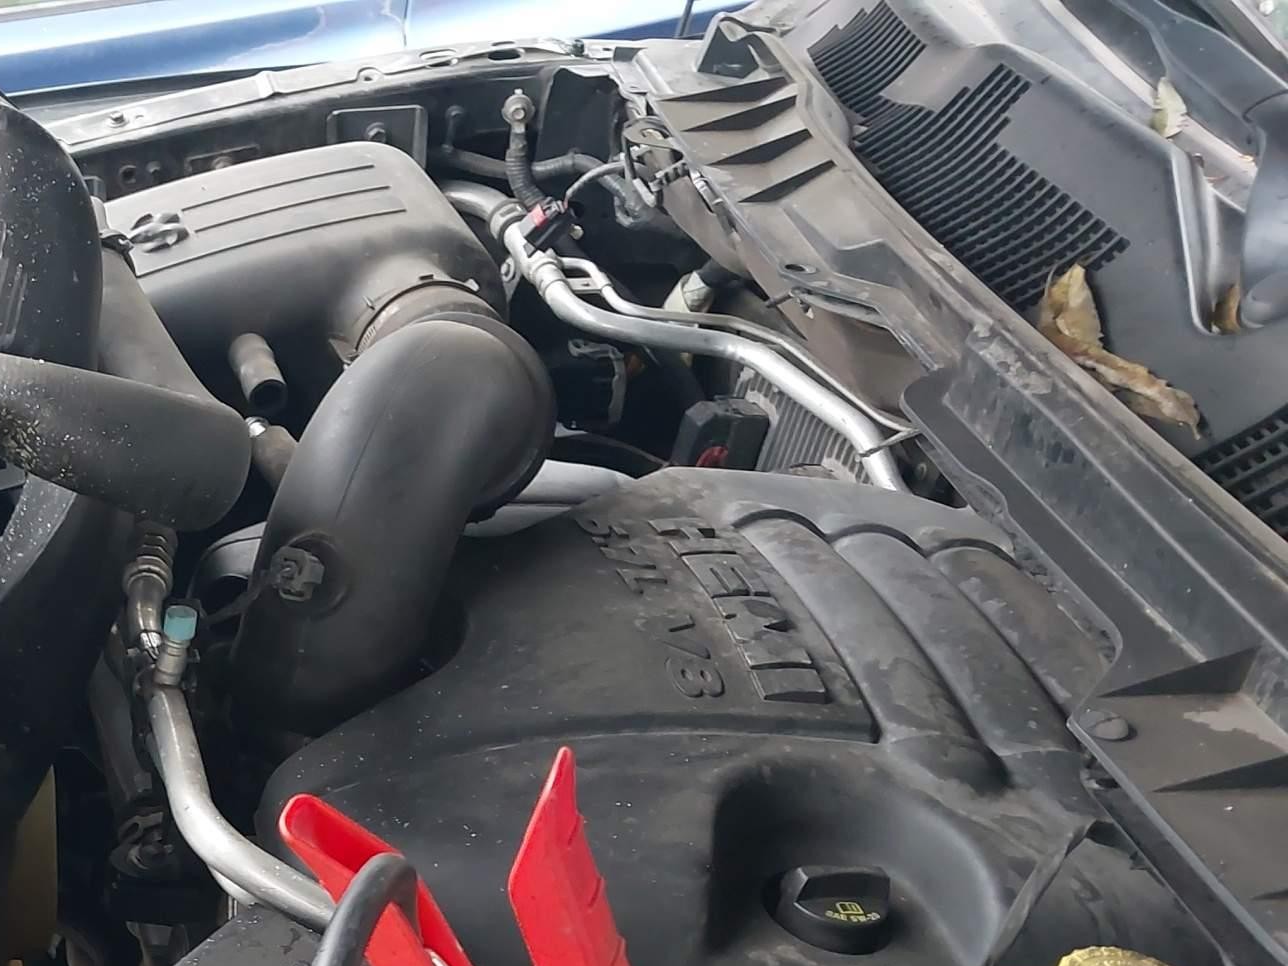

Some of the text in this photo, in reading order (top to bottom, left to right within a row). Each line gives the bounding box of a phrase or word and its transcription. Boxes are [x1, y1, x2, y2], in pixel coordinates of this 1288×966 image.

[574, 515, 725, 700] 5.7L V8
[648, 517, 830, 704] HEMI
